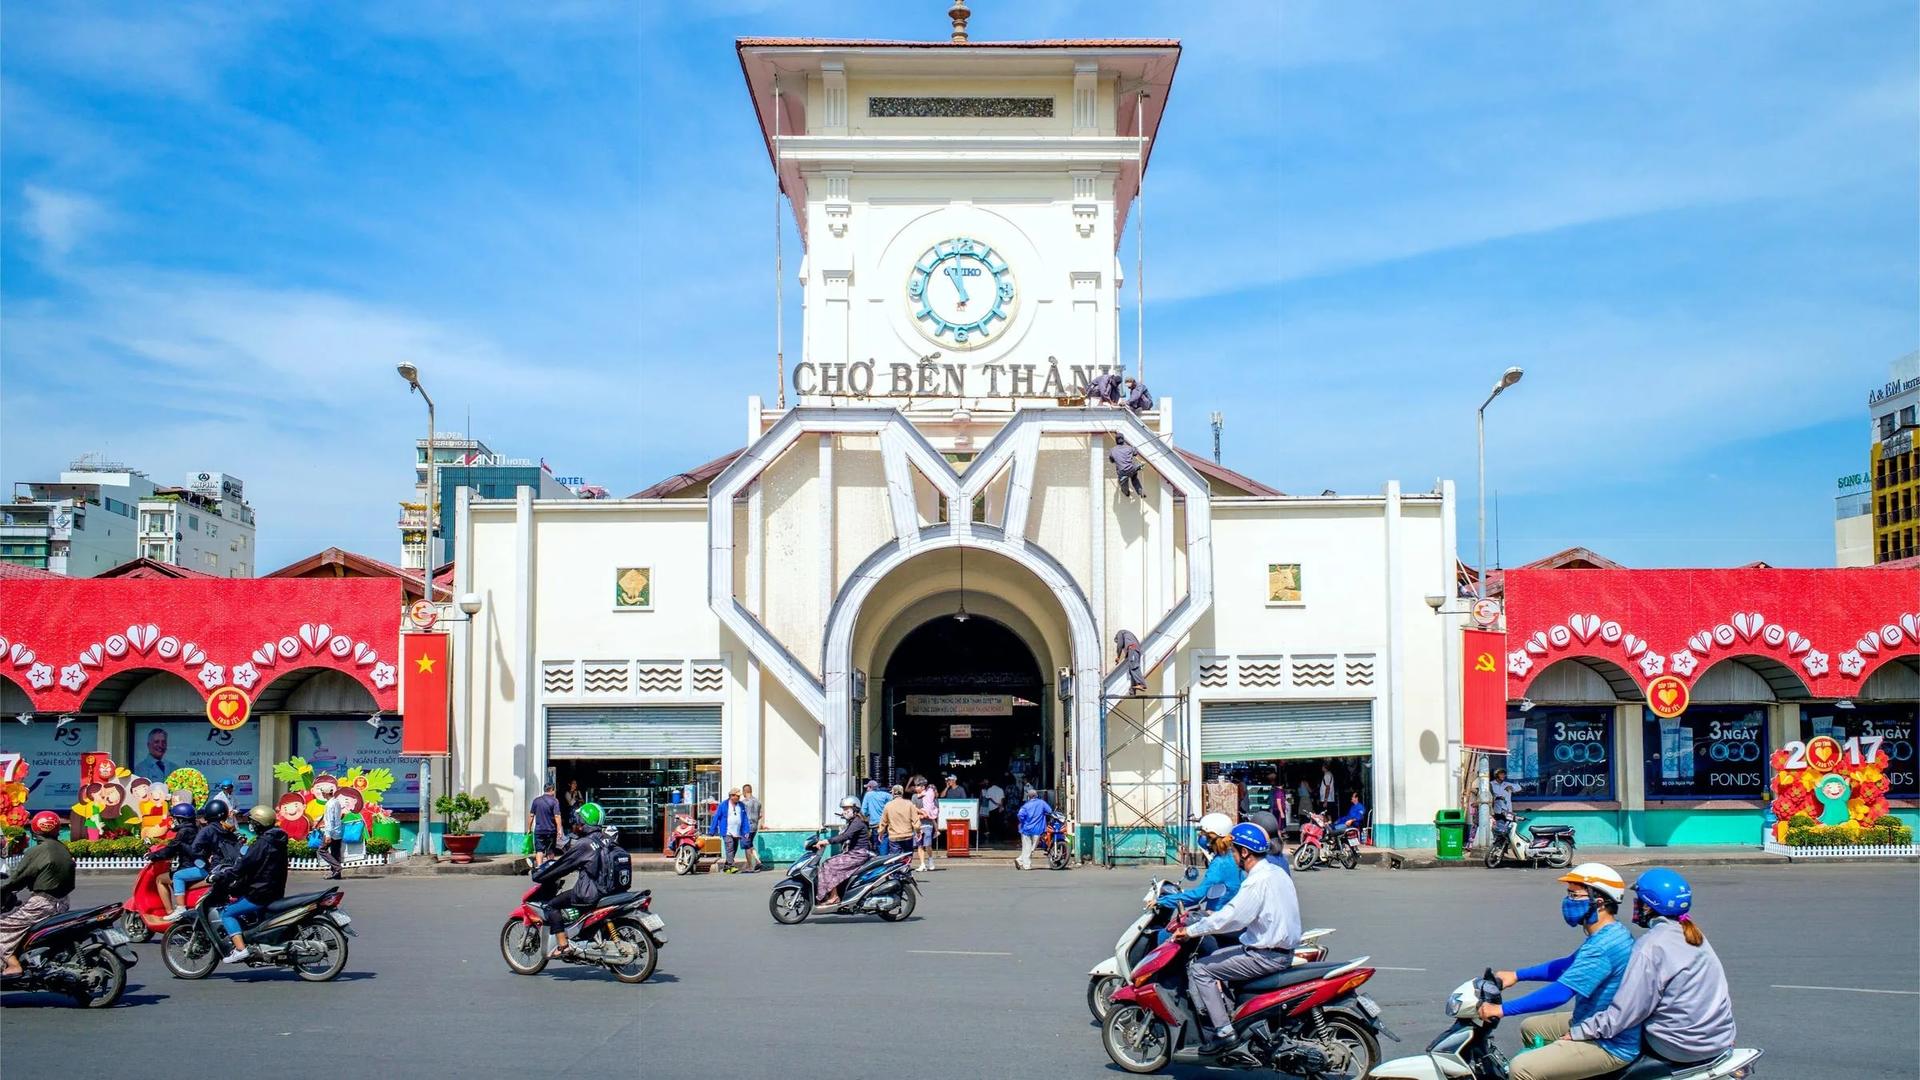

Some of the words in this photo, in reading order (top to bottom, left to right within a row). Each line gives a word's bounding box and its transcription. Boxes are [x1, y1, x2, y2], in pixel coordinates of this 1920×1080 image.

[793, 358, 876, 399] CHỢ
[889, 352, 967, 398] BẾN
[1838, 473, 1862, 489] SONG
[1554, 722, 1566, 741] 3
[1568, 727, 1602, 741] NGÀY
[1709, 721, 1721, 740] 3
[1723, 727, 1759, 740] NGÀY
[1862, 720, 1874, 737] 3
[1875, 726, 1911, 739] NGÀY
[1555, 773, 1606, 788] POND'S
[1710, 773, 1761, 787] POND'S
[1882, 772, 1914, 786] ND'S
